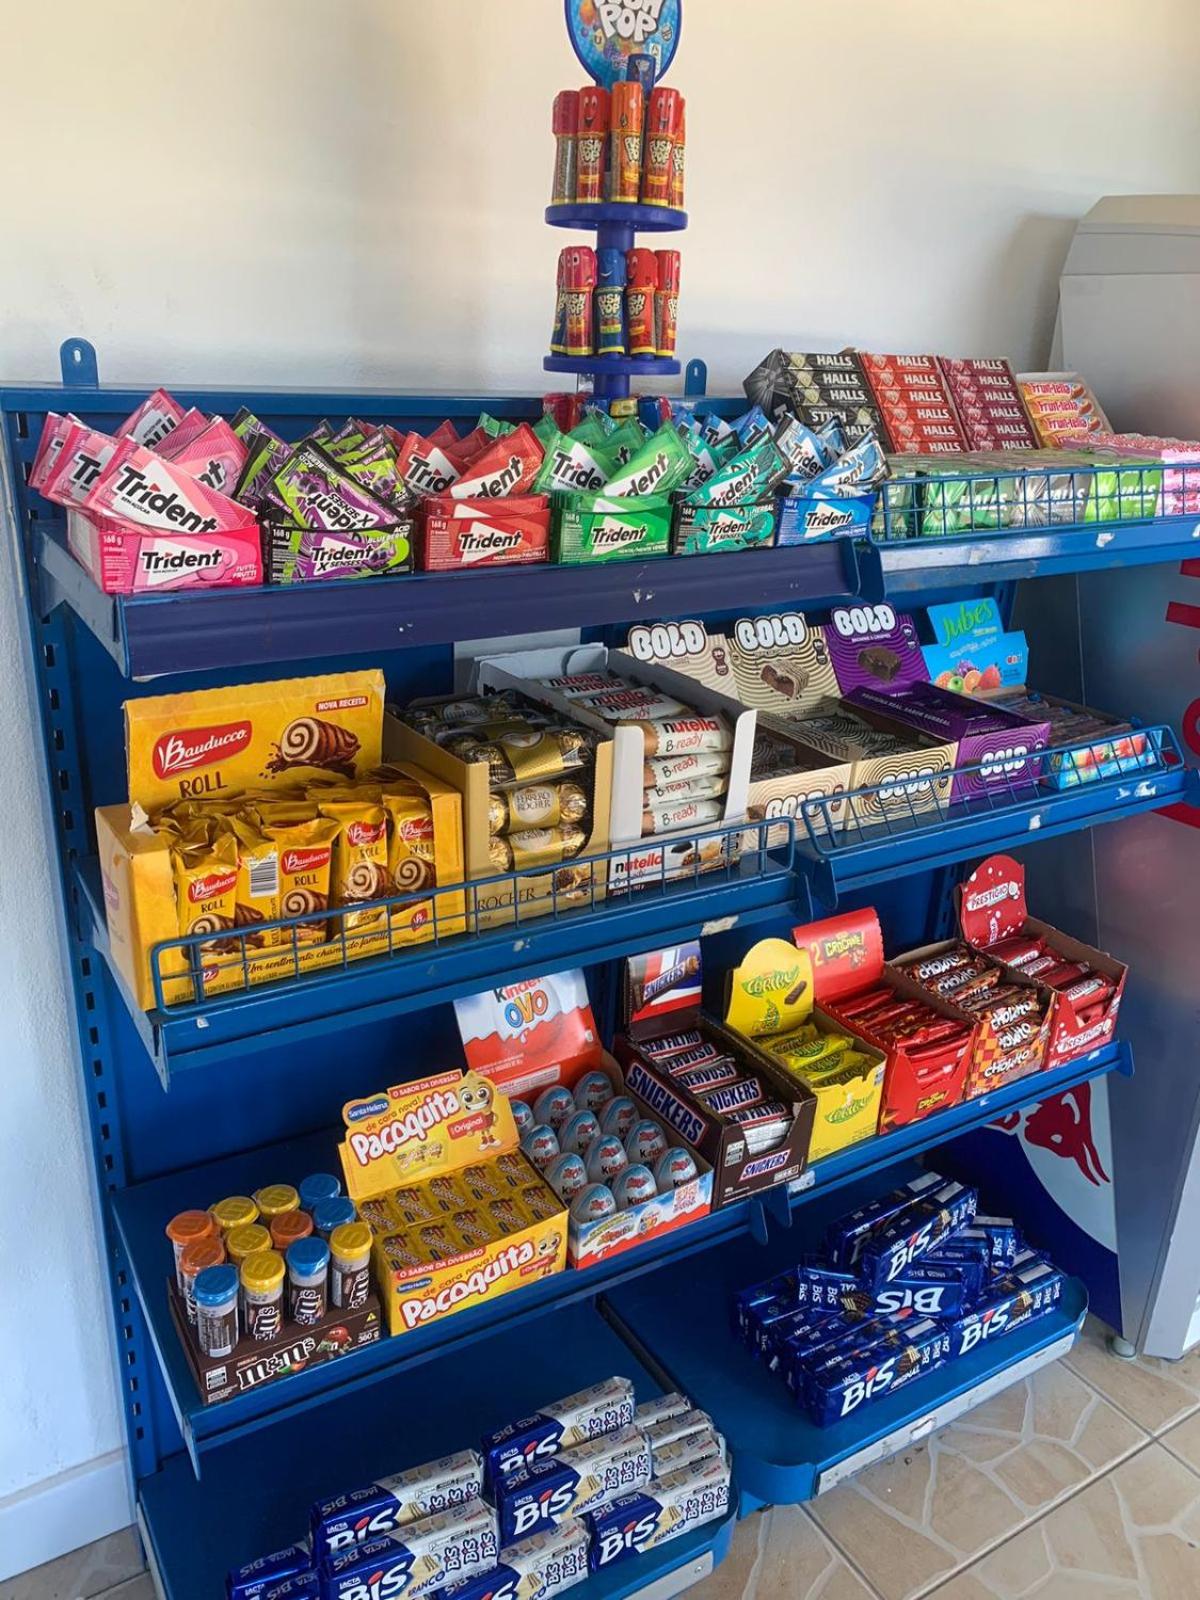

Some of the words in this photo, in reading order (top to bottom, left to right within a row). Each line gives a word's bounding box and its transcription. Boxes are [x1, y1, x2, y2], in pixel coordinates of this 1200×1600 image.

[599, 4, 657, 42] POP
[816, 356, 853, 366] HALLS
[897, 356, 930, 367] HALLS
[973, 360, 1004, 370] HALLS
[823, 373, 860, 385] HALLS
[904, 374, 938, 386] HALLS
[979, 375, 1011, 386] HALLS
[830, 390, 866, 402] HALLS
[909, 391, 943, 402] HALLS
[985, 391, 1015, 402] HALLS
[917, 408, 951, 419] HALLS
[990, 408, 1022, 418] HALLS
[923, 426, 955, 436] HALLS
[996, 424, 1028, 435] HALLS
[929, 442, 961, 453] HALLS
[1002, 440, 1033, 451] HALLS
[407, 457, 455, 492] Trid
[552, 452, 605, 490] Tride
[116, 466, 218, 533] Trident
[710, 521, 752, 534] Trident
[806, 513, 852, 527] Trident
[461, 531, 521, 549] Trident
[593, 525, 646, 542] Trident
[143, 550, 222, 569] Trident
[312, 546, 374, 562] Trident
[318, 562, 330, 571] X
[833, 604, 896, 636] BOLD
[736, 615, 805, 650] BOLD
[631, 623, 705, 660] BOLD
[318, 701, 338, 711] NOVA
[339, 697, 367, 708] RECEITA
[589, 690, 647, 705] nutella
[663, 717, 720, 733] nutella
[158, 729, 248, 772] Bauducco
[178, 771, 229, 798] ROLL
[615, 852, 663, 873] nutella
[294, 874, 319, 886] ROLL
[201, 901, 226, 913] ROLL
[811, 942, 824, 967] 2
[644, 963, 685, 999] SNICKERS
[504, 989, 549, 1028] OVO
[667, 1044, 714, 1070] ERVOSO
[393, 1090, 400, 1098] O
[400, 1084, 420, 1096] SABOR
[420, 1082, 430, 1091] DA
[429, 1073, 459, 1089] DIVERSÃO
[628, 1065, 703, 1144] SNICKERS
[706, 1081, 760, 1111] NICKERS
[348, 1106, 368, 1118] Santa
[368, 1101, 388, 1115] Helena
[366, 1122, 376, 1133] de
[377, 1113, 397, 1128] cara
[398, 1096, 421, 1116] nova!
[352, 1090, 461, 1165] Paçoquita
[744, 1152, 788, 1177] SNICKERS
[400, 1270, 407, 1279] O
[407, 1263, 435, 1277] SABOR
[436, 1260, 447, 1270] DA
[448, 1249, 484, 1267] DIVERSÃO
[402, 1242, 534, 1327] Paçoquita
[423, 1287, 436, 1298] de
[438, 1275, 464, 1291] cara
